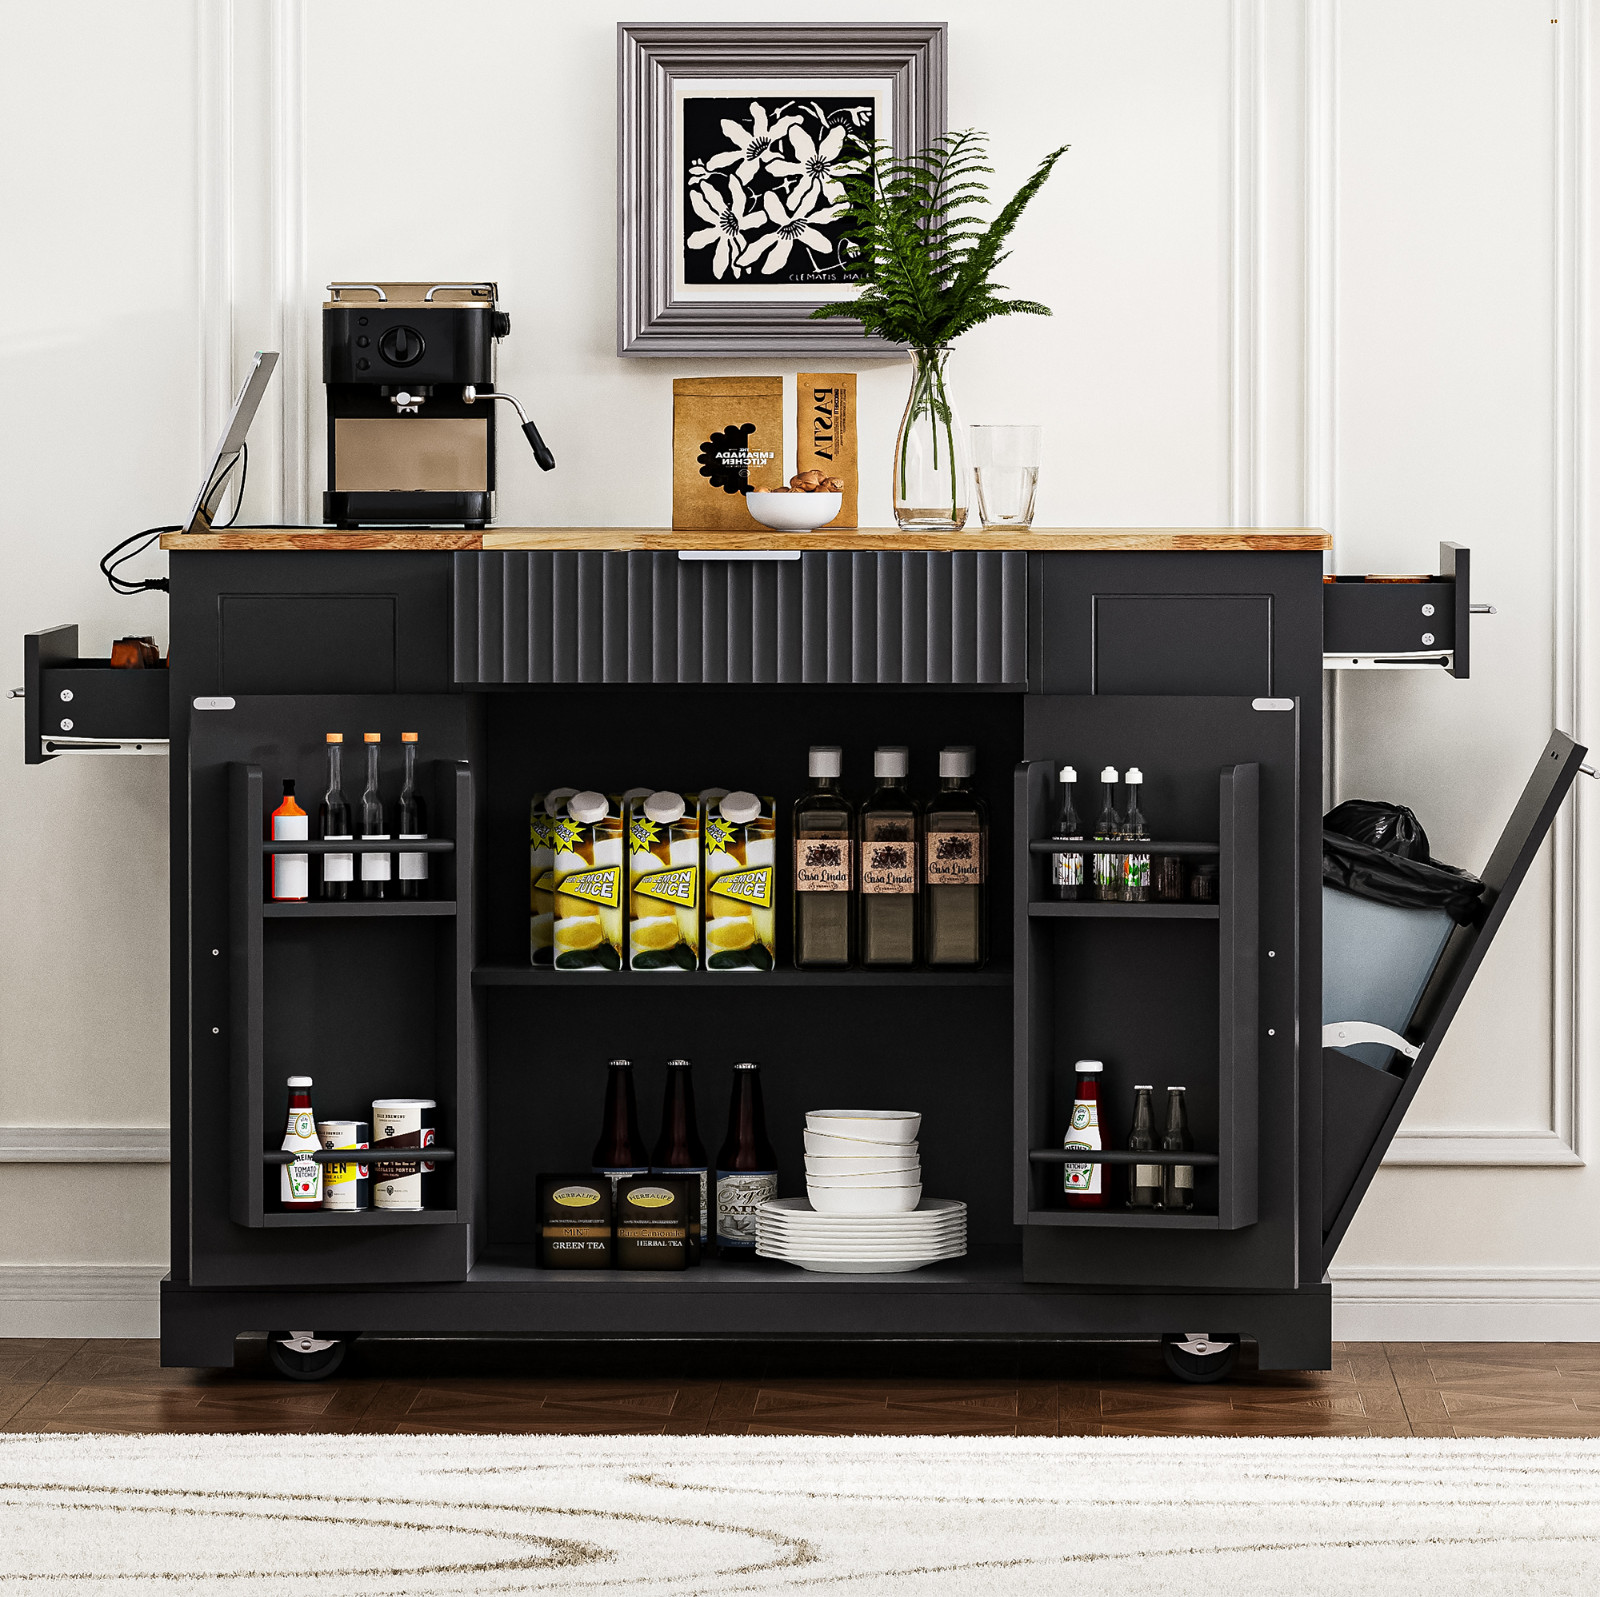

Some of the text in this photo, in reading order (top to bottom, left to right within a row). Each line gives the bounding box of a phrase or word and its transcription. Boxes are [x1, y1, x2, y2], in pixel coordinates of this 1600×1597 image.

[788, 273, 837, 281] CLEMATIS
[930, 862, 950, 874] Casa
[576, 871, 615, 883] LEMON
[653, 871, 691, 883] LEMON
[729, 871, 767, 883] LEMON
[798, 869, 846, 882] Casa Linda
[864, 871, 912, 885] Casa Linda
[575, 883, 613, 898] JUICE
[651, 883, 689, 898] JUICE
[727, 883, 765, 898] JUICE
[554, 1192, 598, 1201] HERBALIFE
[629, 1193, 673, 1201] HERBALIFE
[552, 1241, 605, 1250] GREEN TEA
